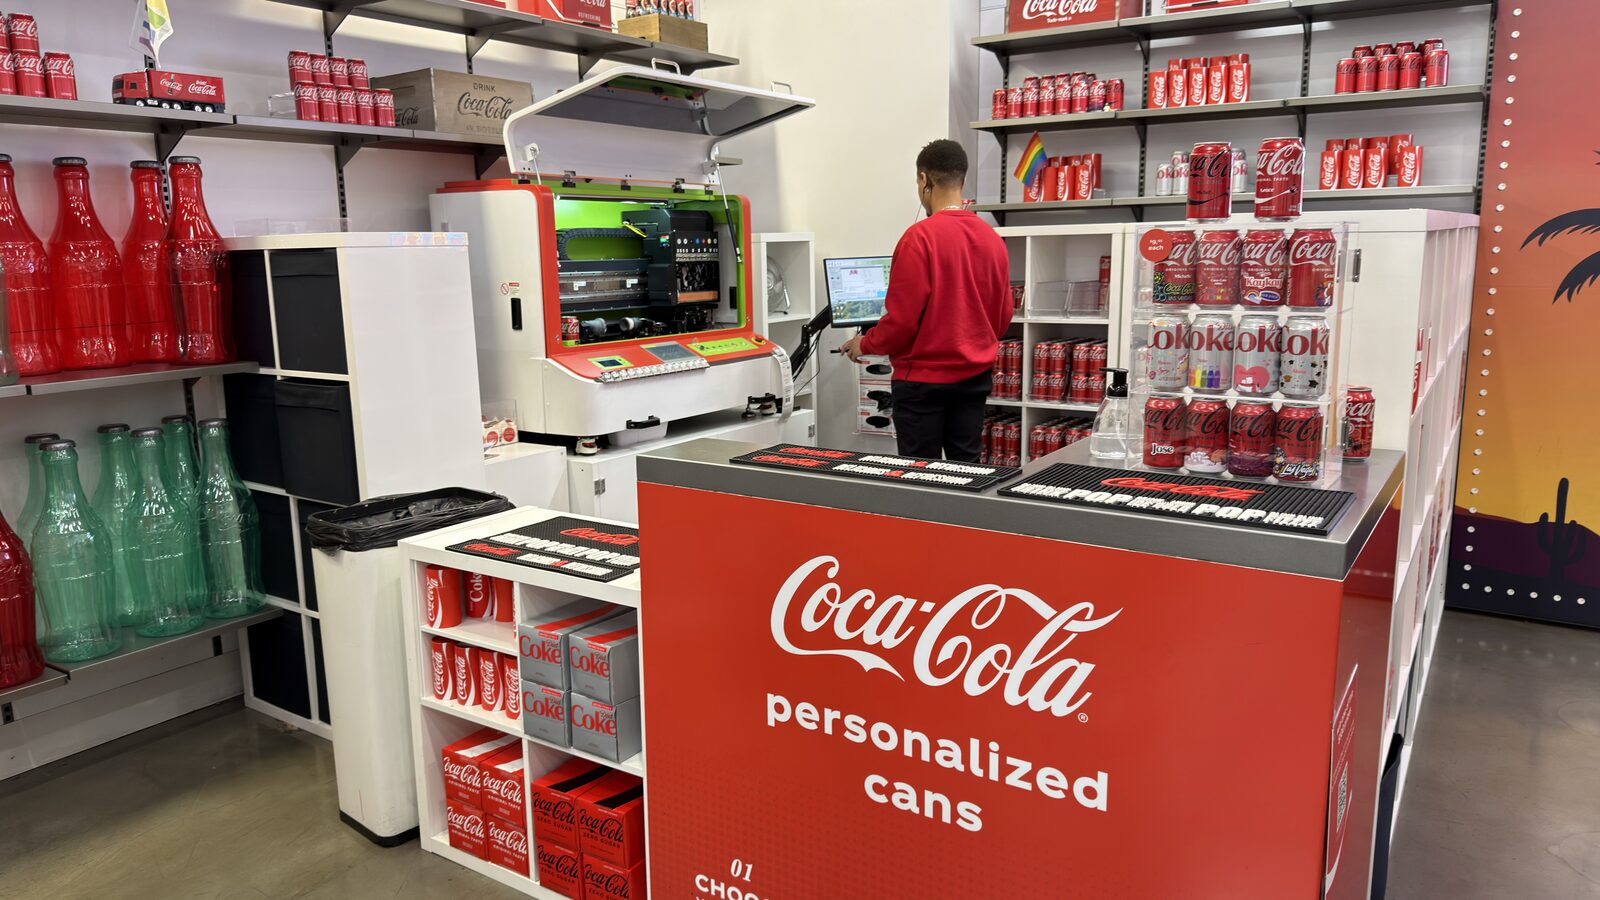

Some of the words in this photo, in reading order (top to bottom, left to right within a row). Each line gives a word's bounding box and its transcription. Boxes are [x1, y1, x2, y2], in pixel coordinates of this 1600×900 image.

[188, 83, 216, 96] Coca-Cola
[473, 82, 496, 93] DRINK
[457, 91, 513, 120] Coca-Cola
[1150, 442, 1175, 456] Jose
[519, 635, 561, 665] Coke
[770, 555, 1124, 717] Coca-Cola
[569, 646, 609, 679] Coke
[480, 658, 496, 705] Coca-Cola
[522, 691, 565, 721] Coke
[571, 704, 617, 736] Coke
[766, 692, 1109, 812] personalized
[864, 774, 983, 832] cans
[730, 858, 753, 882] 01
